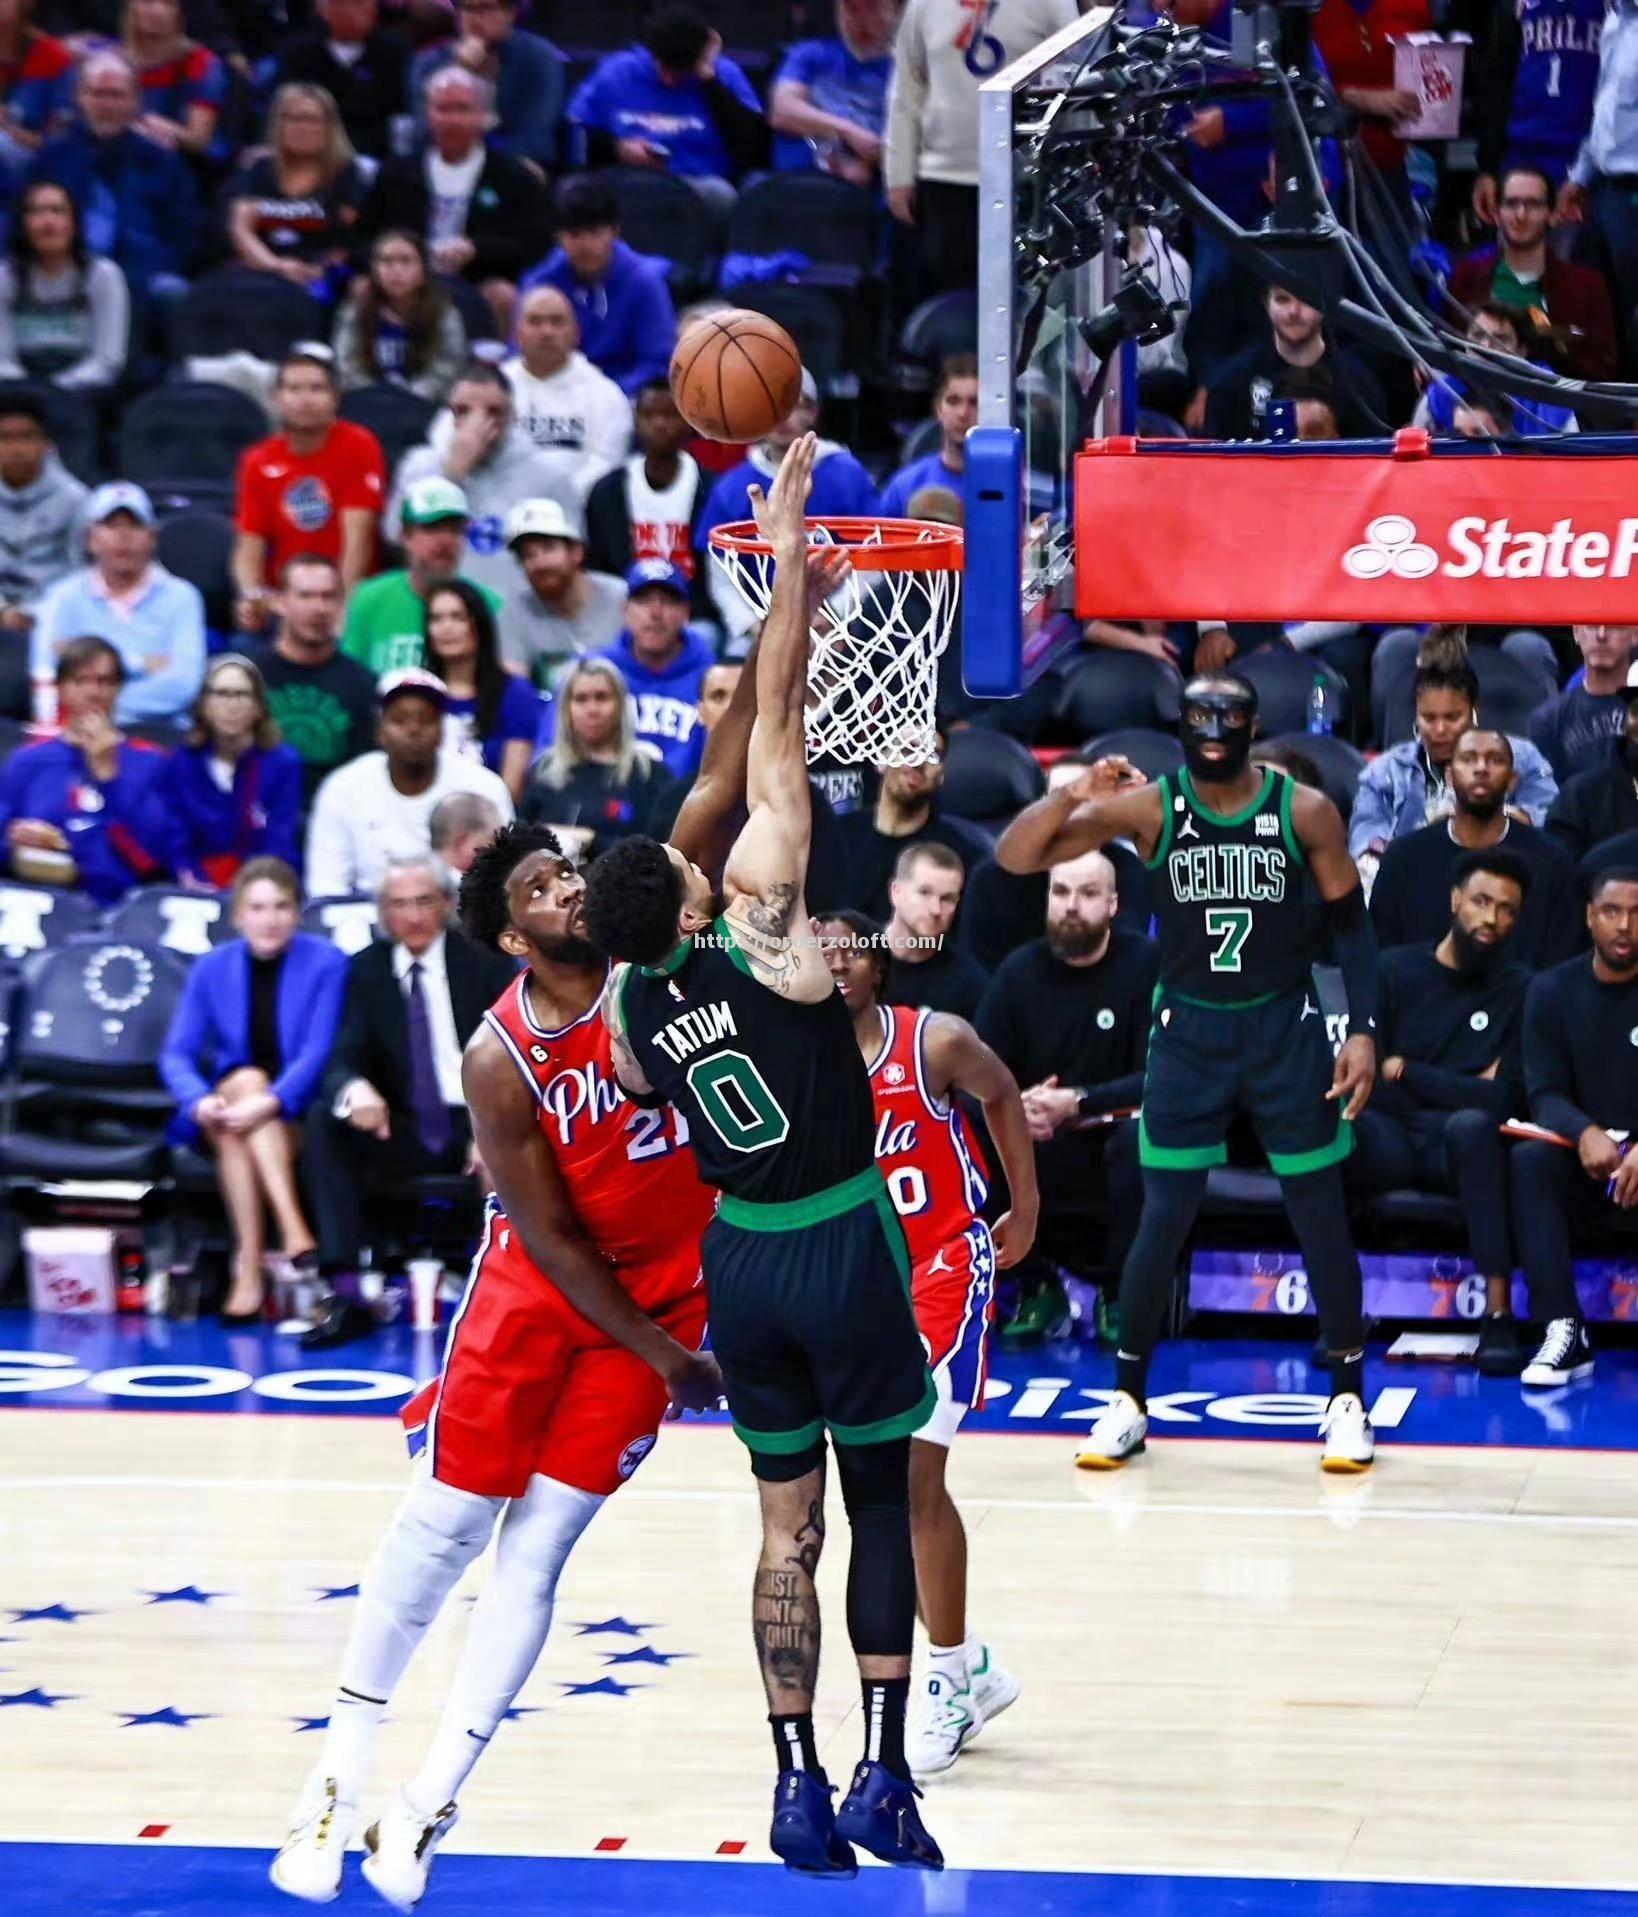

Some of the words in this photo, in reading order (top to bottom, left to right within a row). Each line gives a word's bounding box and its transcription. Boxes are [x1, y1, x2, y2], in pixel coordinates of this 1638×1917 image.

[1546, 53, 1561, 98] 1
[1168, 842, 1287, 903] CELTICS
[1205, 907, 1253, 973] 7
[529, 1044, 549, 1064] 6
[651, 1000, 738, 1064] TATUM
[686, 1049, 790, 1153] 0
[1250, 1268, 1309, 1315] 76
[1429, 1273, 1488, 1319] 76
